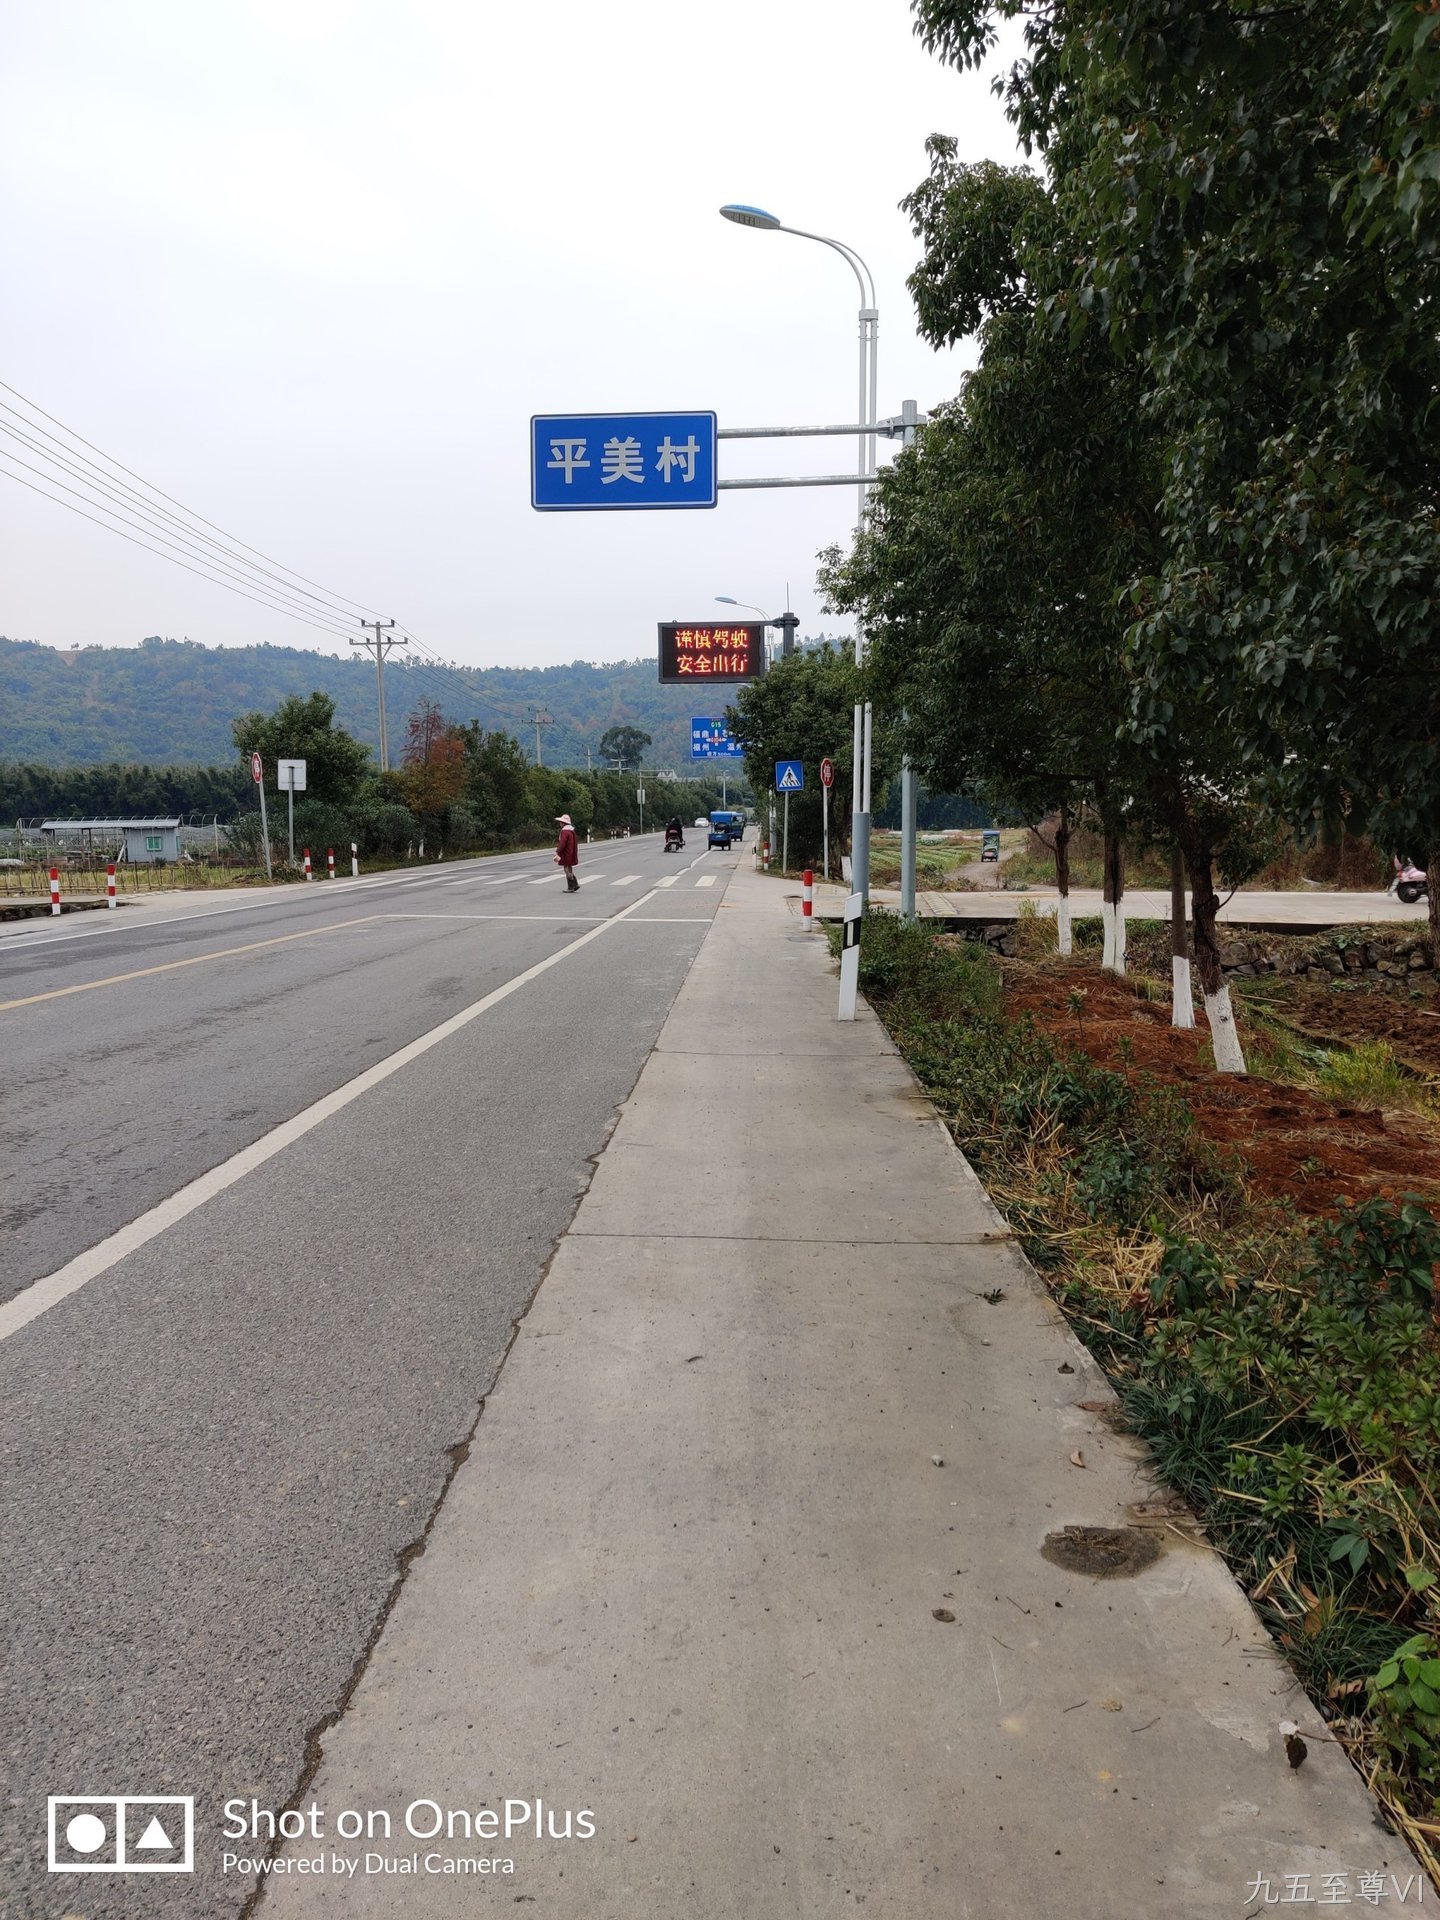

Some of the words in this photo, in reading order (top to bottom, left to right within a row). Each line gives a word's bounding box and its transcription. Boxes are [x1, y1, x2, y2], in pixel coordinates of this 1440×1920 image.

[547, 435, 700, 484] 平美村
[675, 629, 748, 649] 谨慎驾驶
[677, 654, 748, 673] 安全出行
[823, 763, 832, 783] 停
